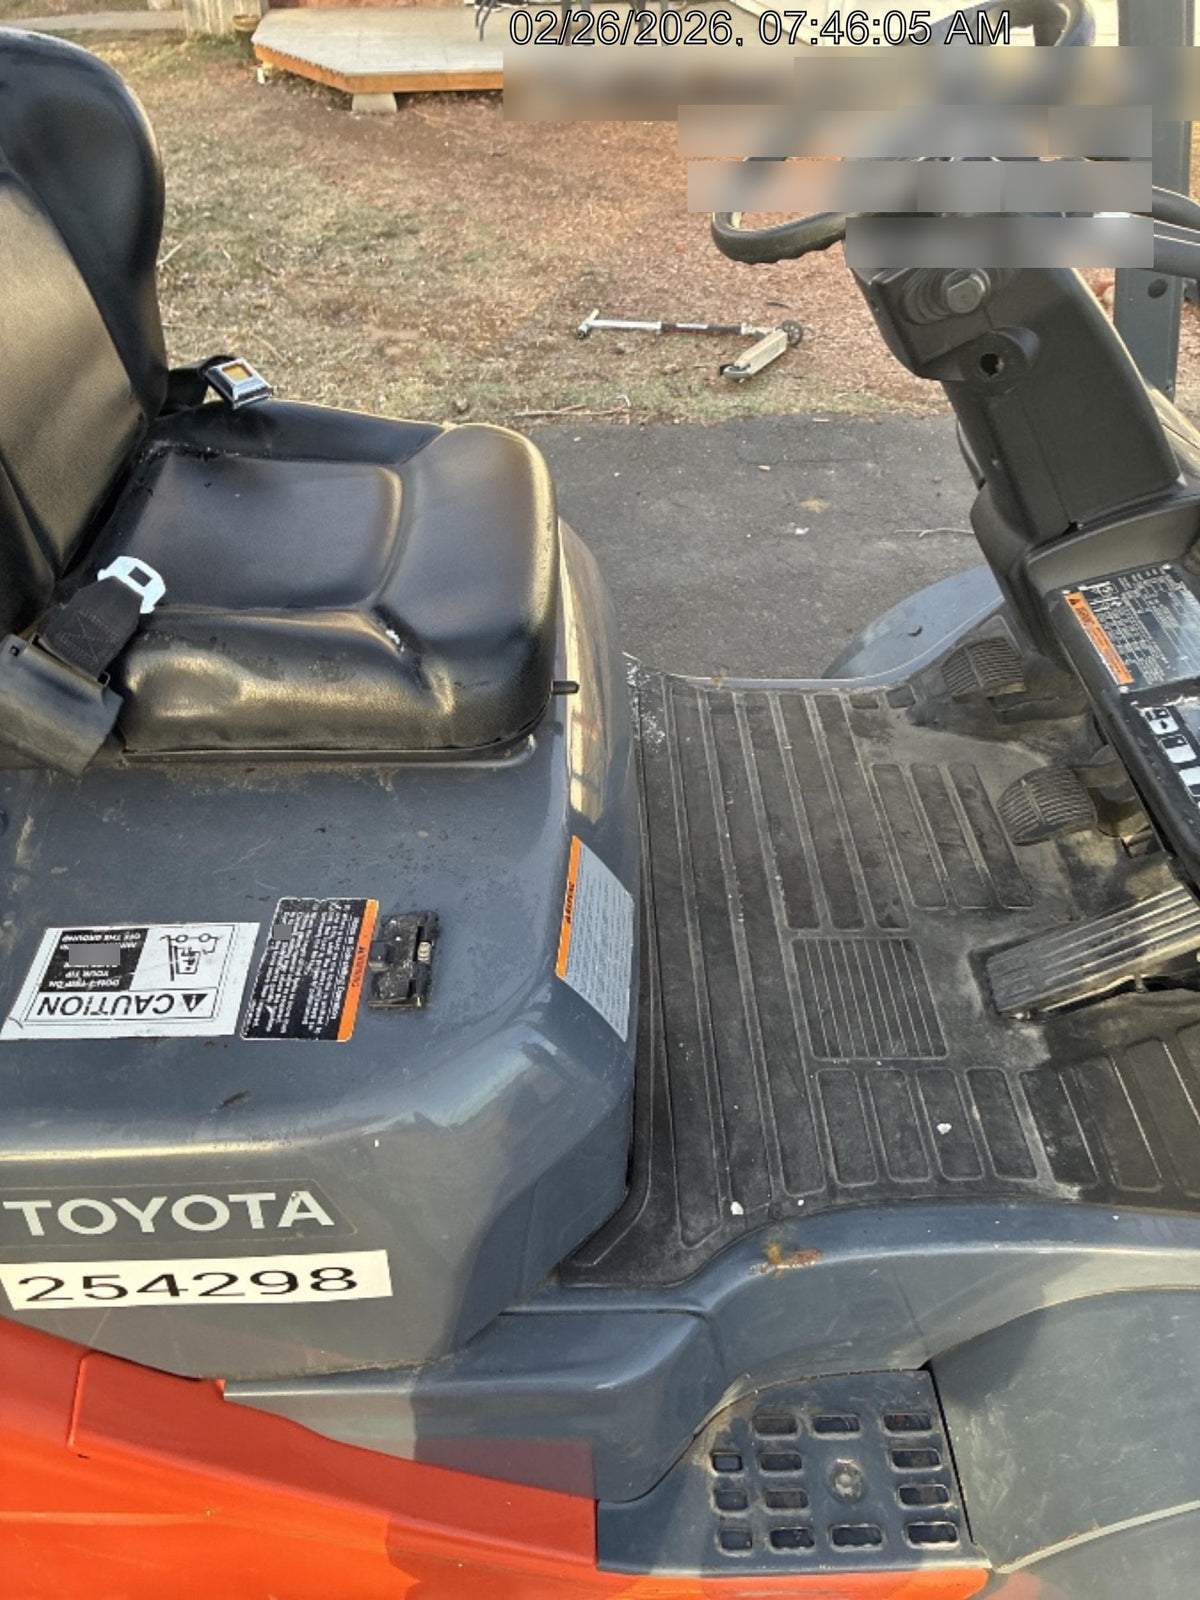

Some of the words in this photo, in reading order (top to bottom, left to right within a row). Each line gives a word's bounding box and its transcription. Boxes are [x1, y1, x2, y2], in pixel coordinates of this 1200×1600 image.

[37, 994, 174, 1016] CAUTION
[3, 1191, 335, 1237] TOYOTA
[18, 1267, 358, 1303] 254298
